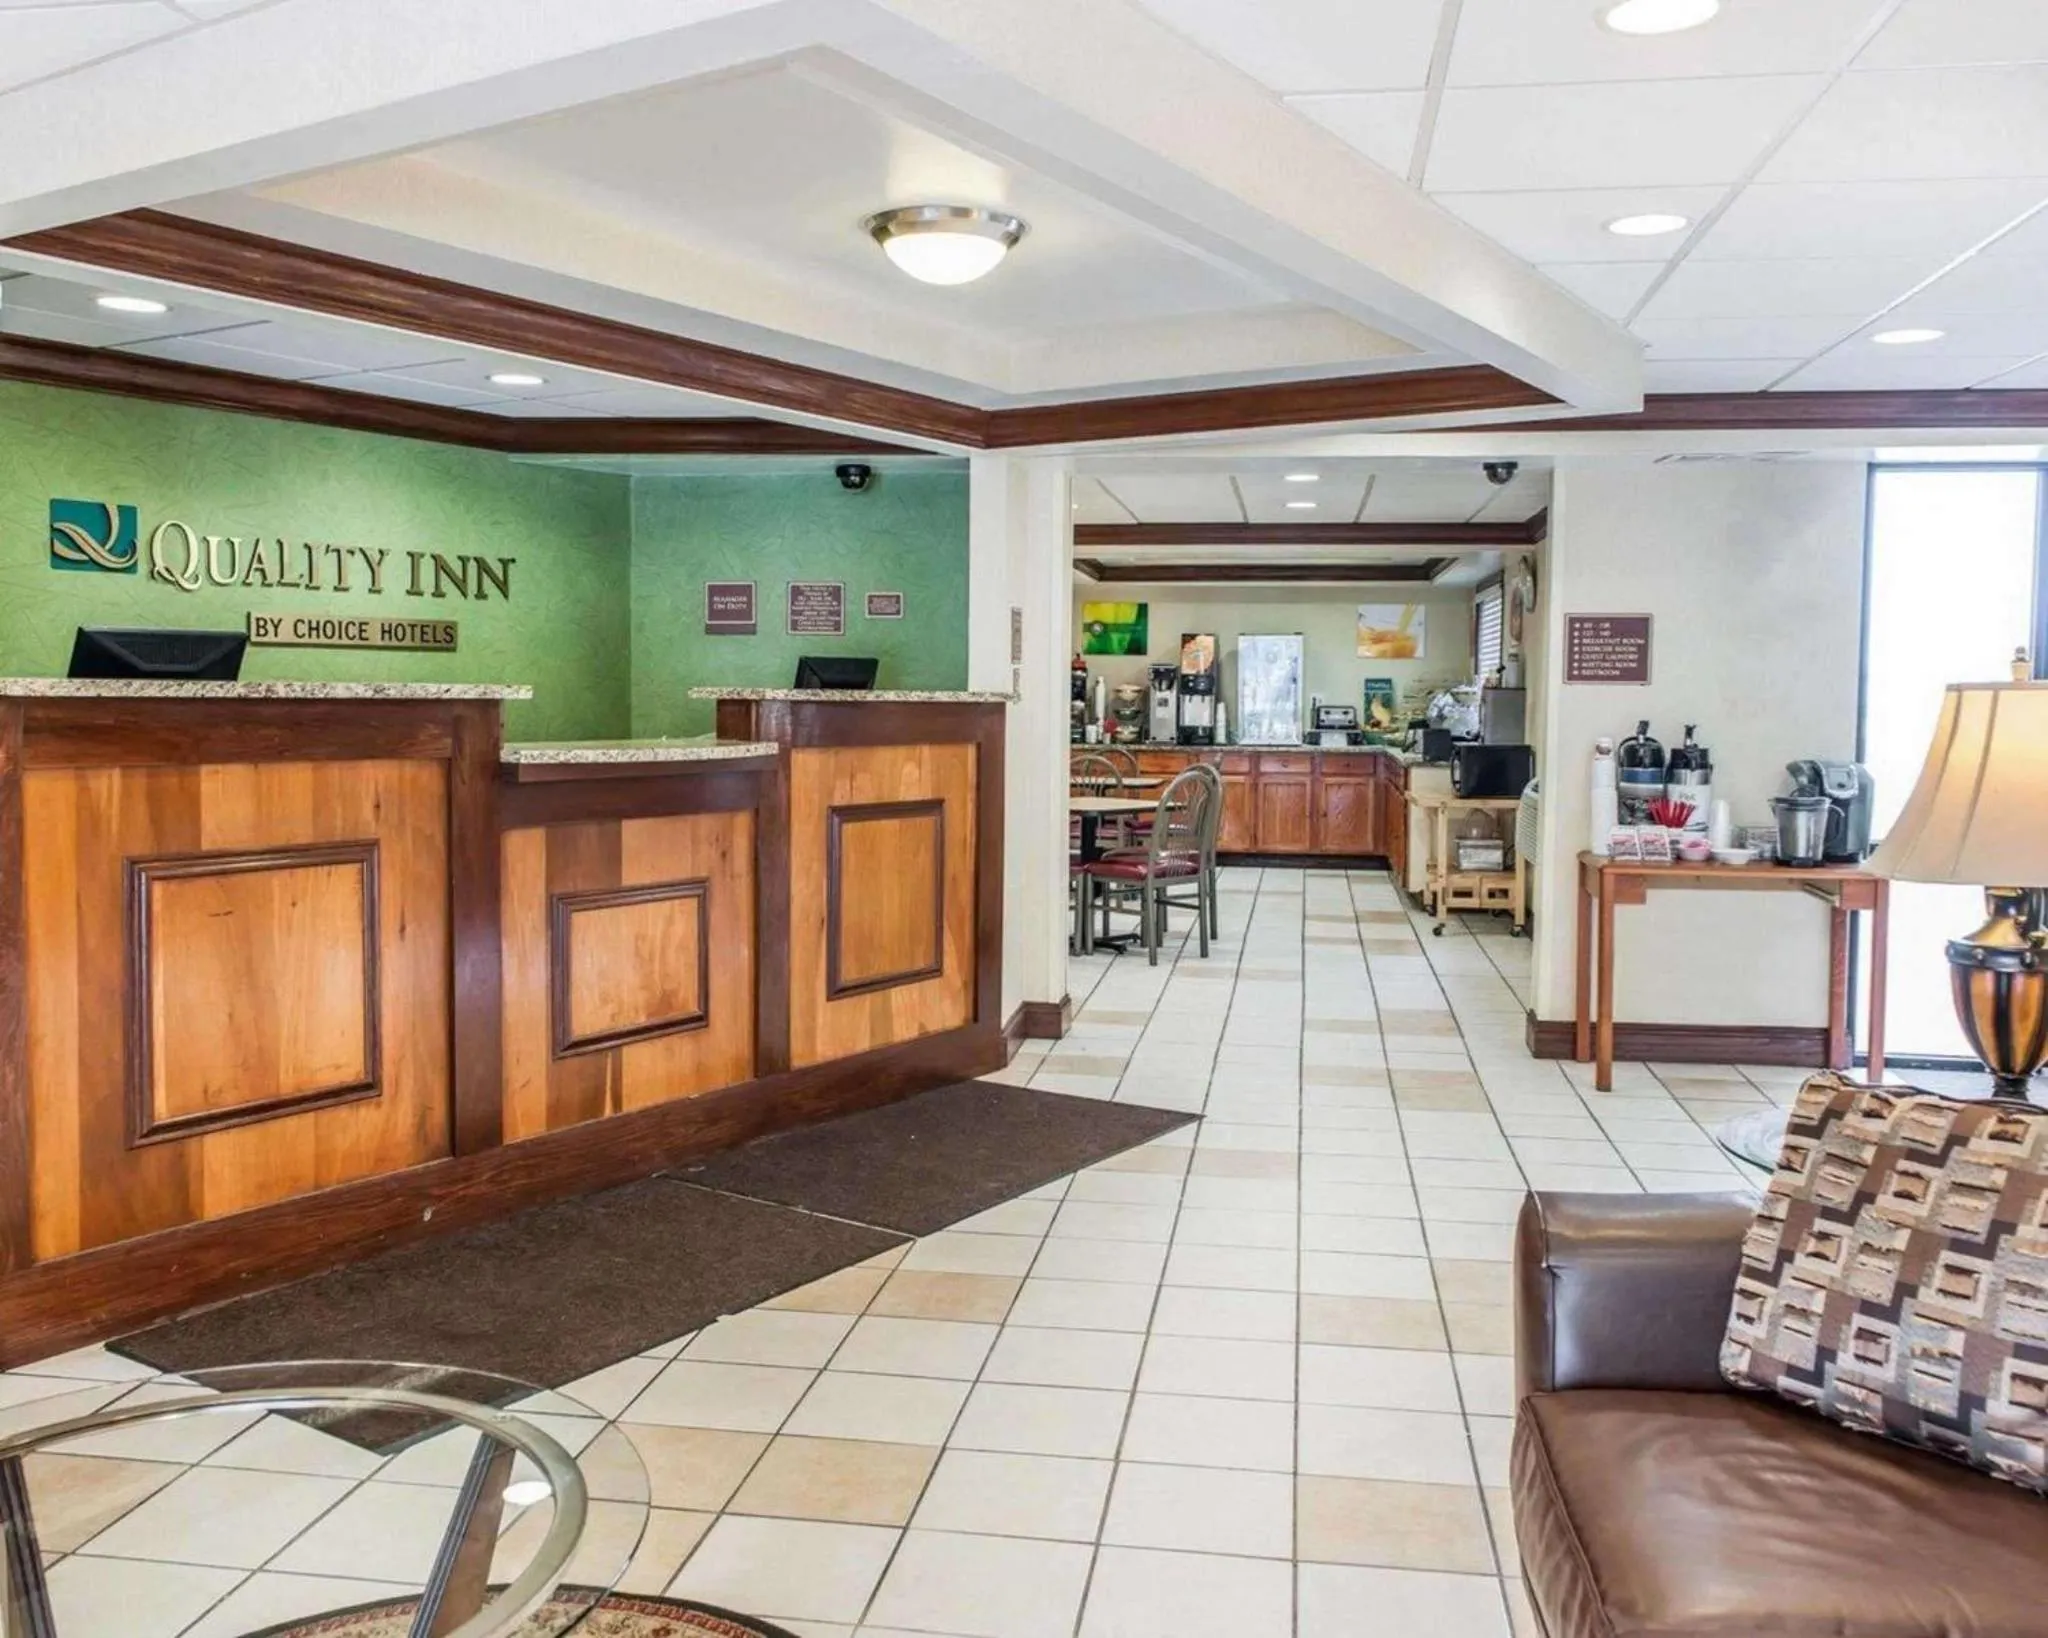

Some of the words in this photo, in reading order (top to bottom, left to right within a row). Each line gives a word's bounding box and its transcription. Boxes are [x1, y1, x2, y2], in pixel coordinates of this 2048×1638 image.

[151, 520, 391, 593] QUALITY
[405, 551, 516, 601] INN
[255, 617, 282, 638] BY
[293, 618, 370, 641] CHOICE
[380, 622, 454, 644] HOTELS
